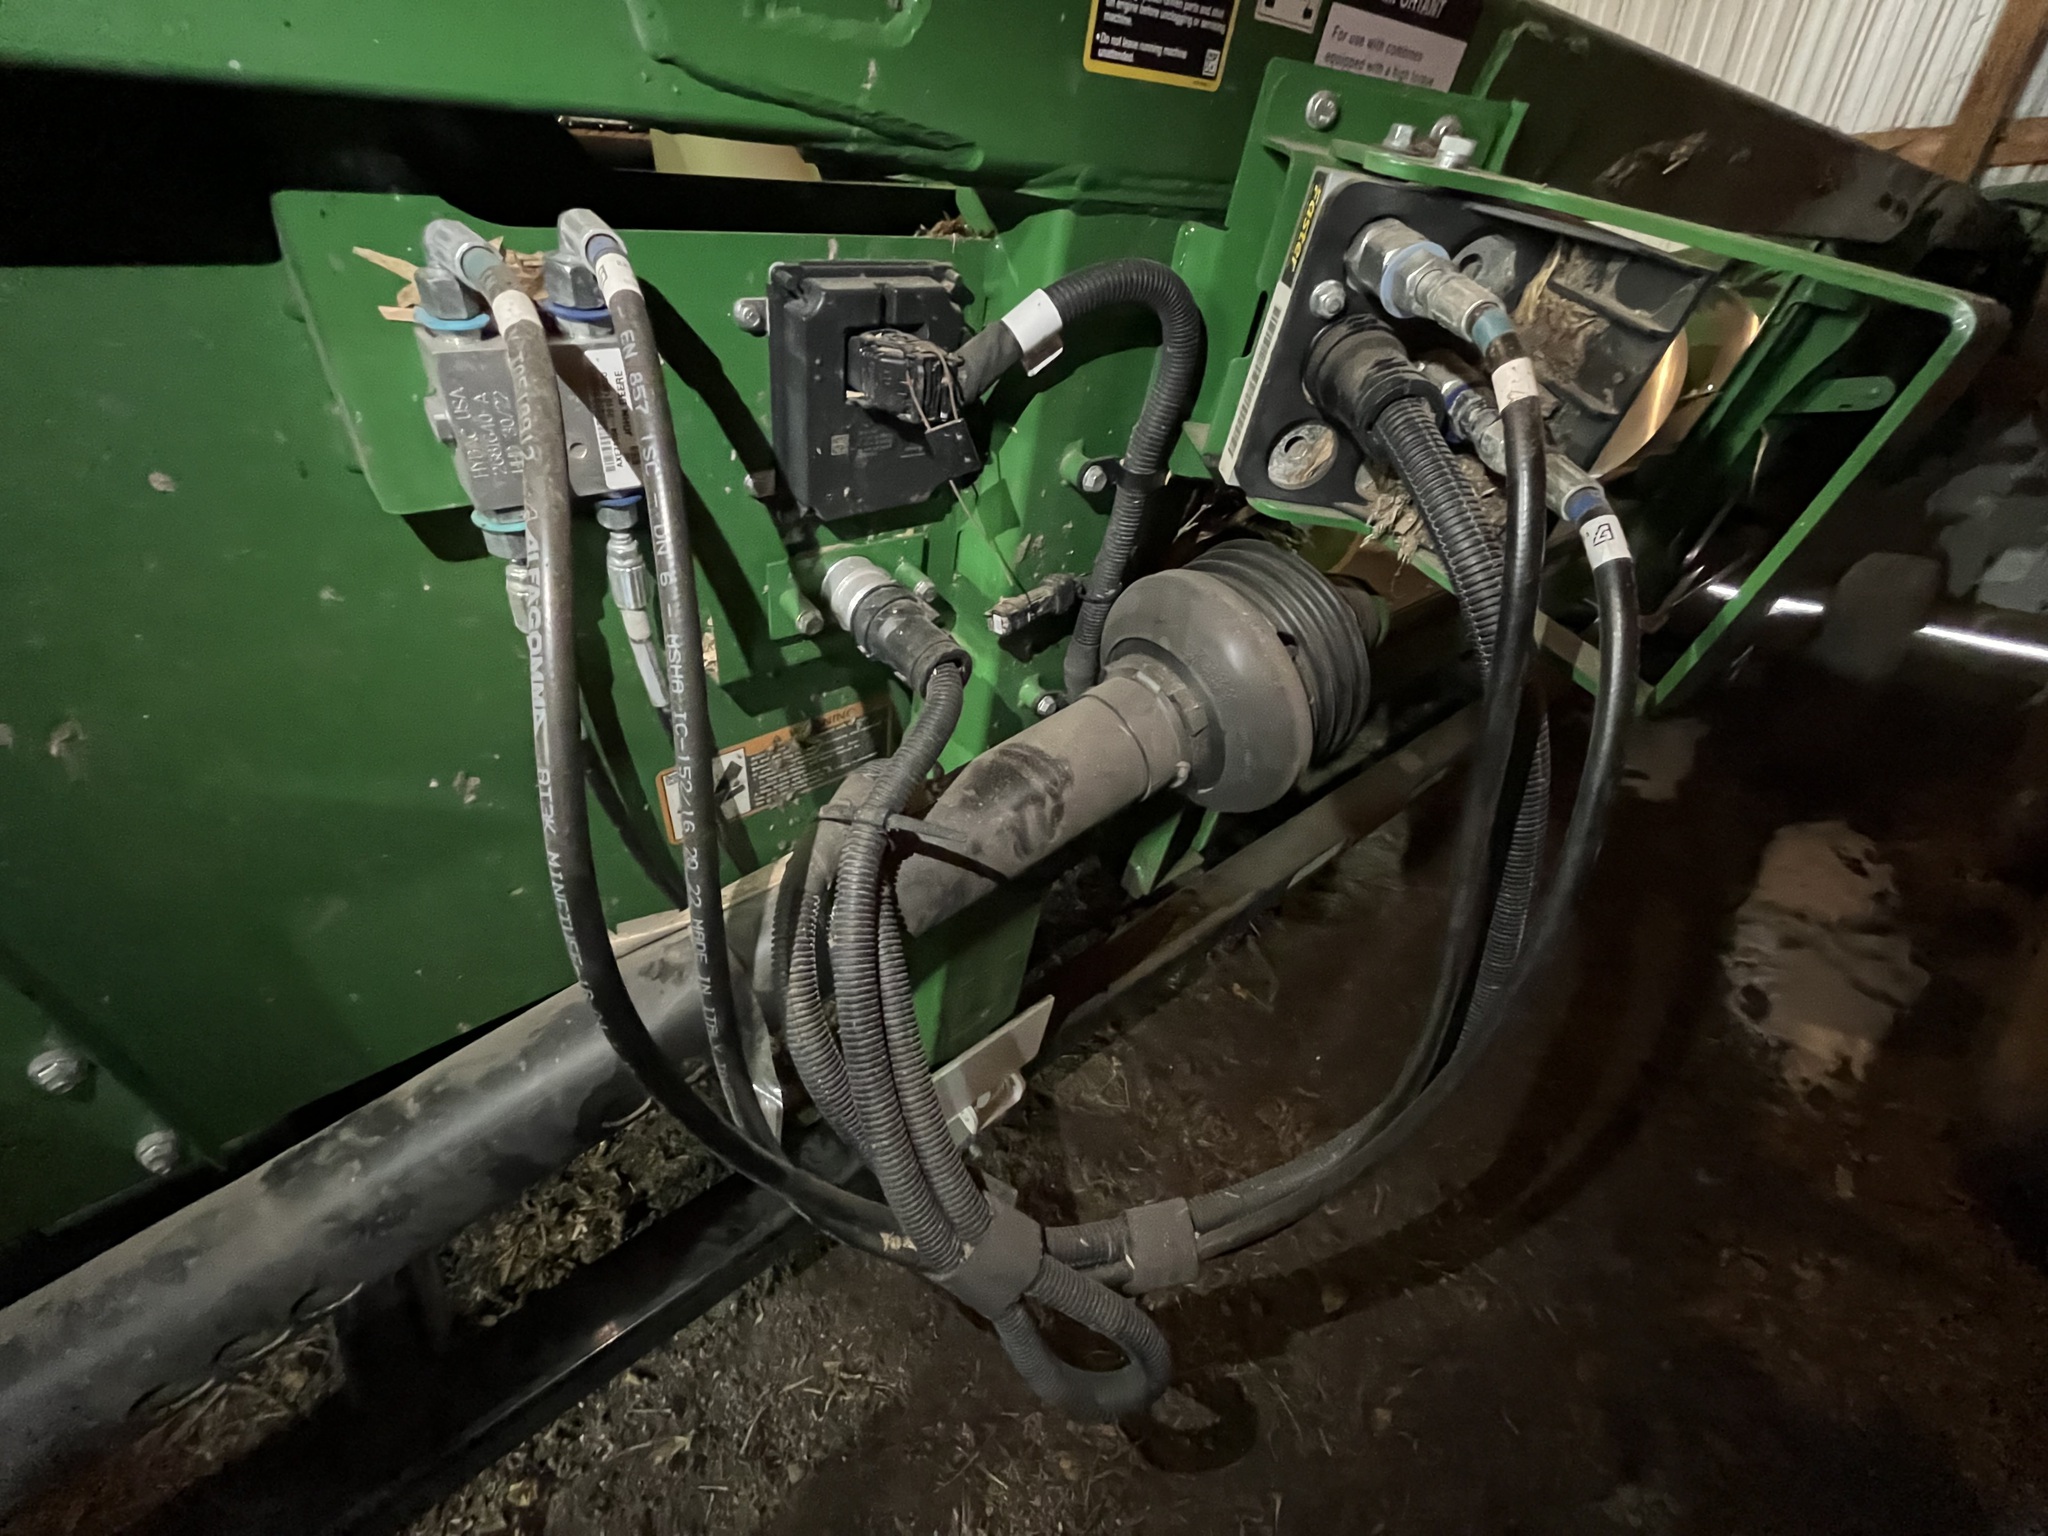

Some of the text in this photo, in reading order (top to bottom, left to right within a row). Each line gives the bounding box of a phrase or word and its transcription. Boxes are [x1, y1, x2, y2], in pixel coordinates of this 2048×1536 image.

[1291, 184, 1322, 272] Faster
[619, 328, 638, 360] EN
[449, 386, 472, 420] USA
[629, 371, 650, 415] 857
[526, 526, 548, 737] ALFAGOMMA
[666, 634, 685, 694] MSHA
[674, 711, 696, 833] IC-152/16
[691, 919, 709, 965] MADE
[699, 976, 713, 996] IN
